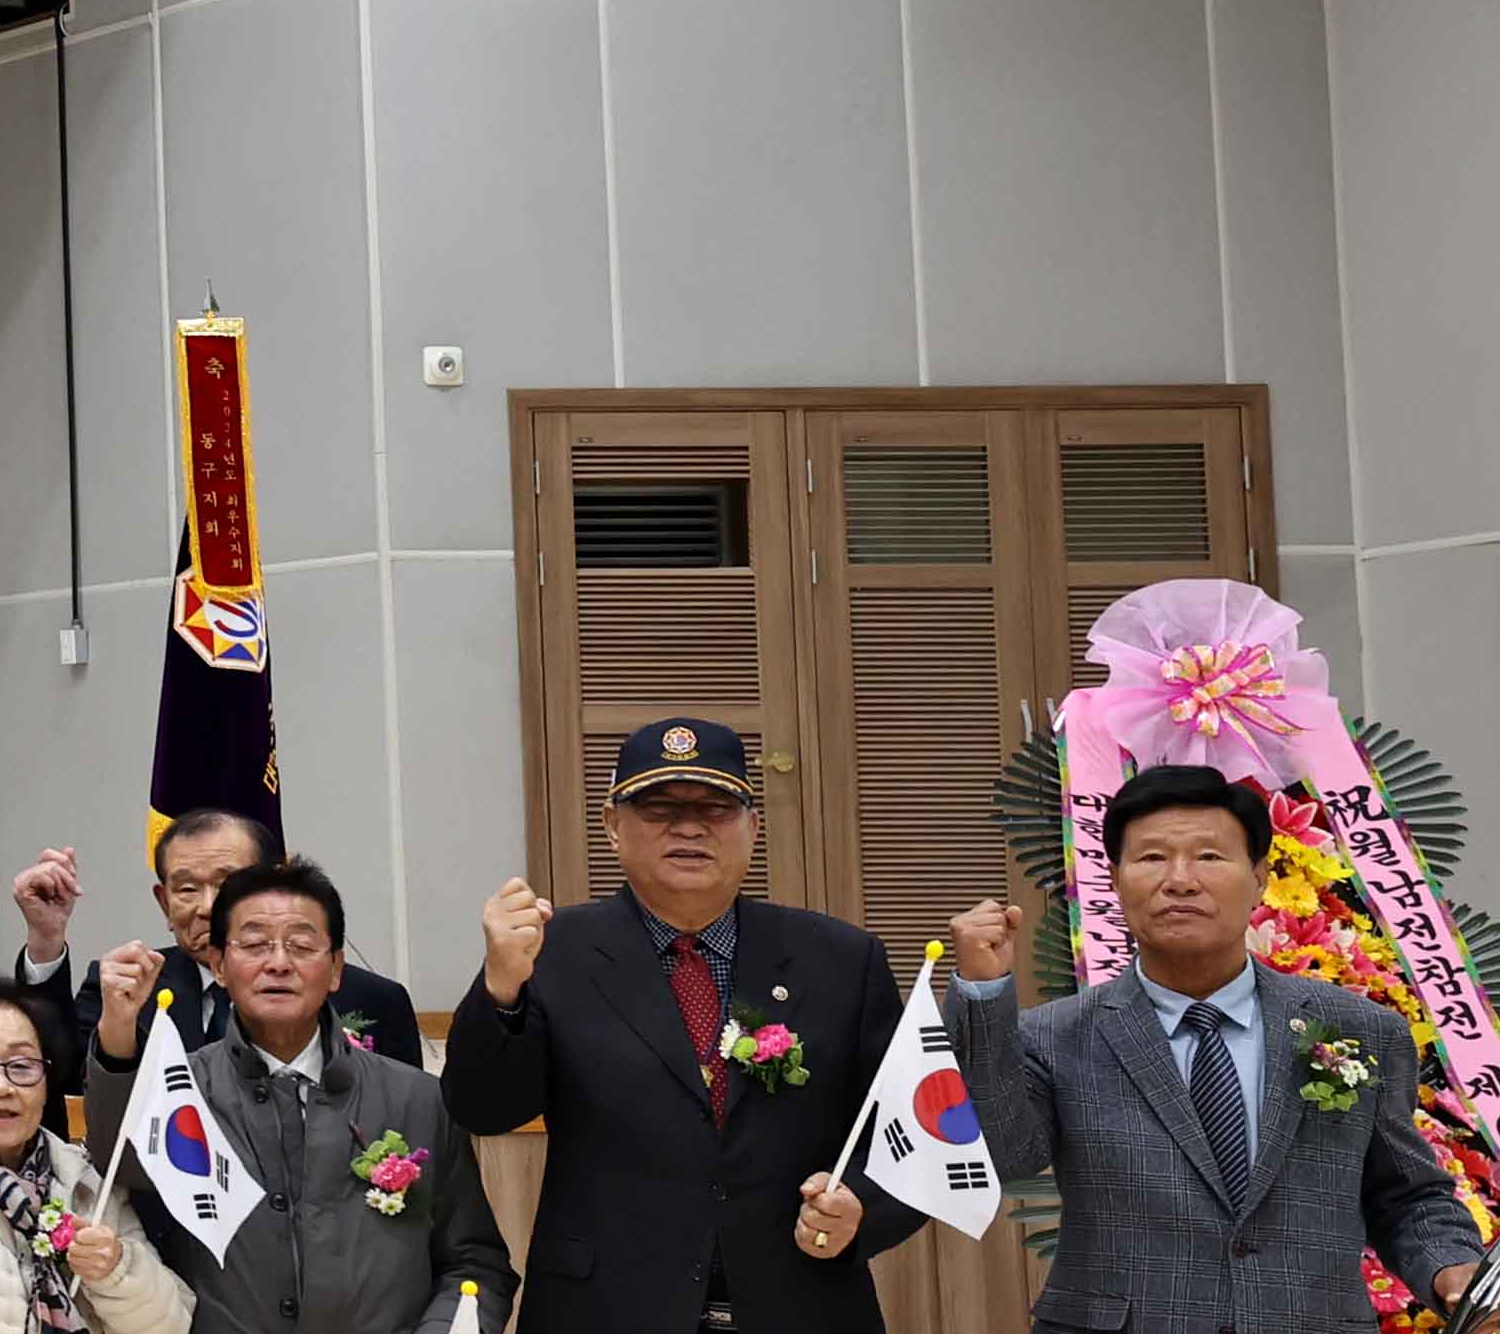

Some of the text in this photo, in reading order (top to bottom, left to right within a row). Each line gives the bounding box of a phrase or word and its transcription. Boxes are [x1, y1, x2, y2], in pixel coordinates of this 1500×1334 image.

[204, 356, 225, 380] 축
[200, 432, 220, 538] 동구지회
[1324, 785, 1391, 828] 祝
[1349, 827, 1483, 1041] 월남전참전
